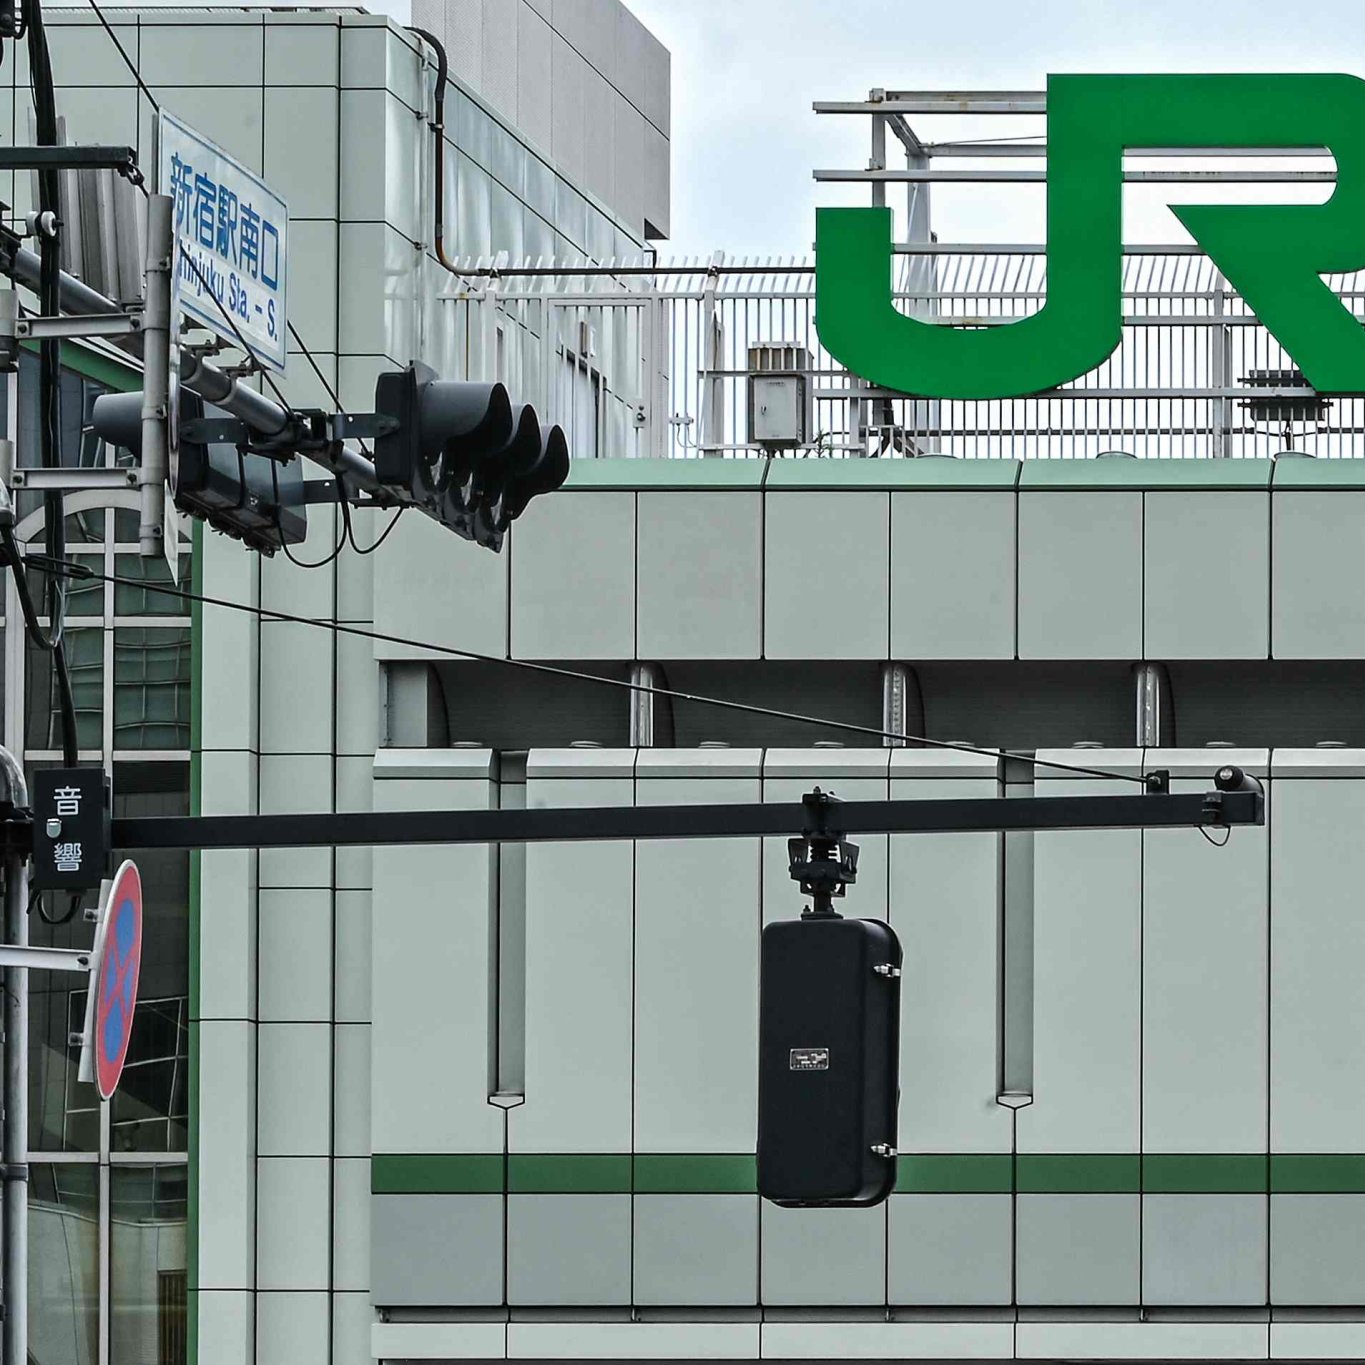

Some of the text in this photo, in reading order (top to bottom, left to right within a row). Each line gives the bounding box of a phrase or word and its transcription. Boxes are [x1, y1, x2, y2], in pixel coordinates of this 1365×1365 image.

[170, 152, 279, 291] 新宿駅南口
[54, 786, 82, 872] 音響
